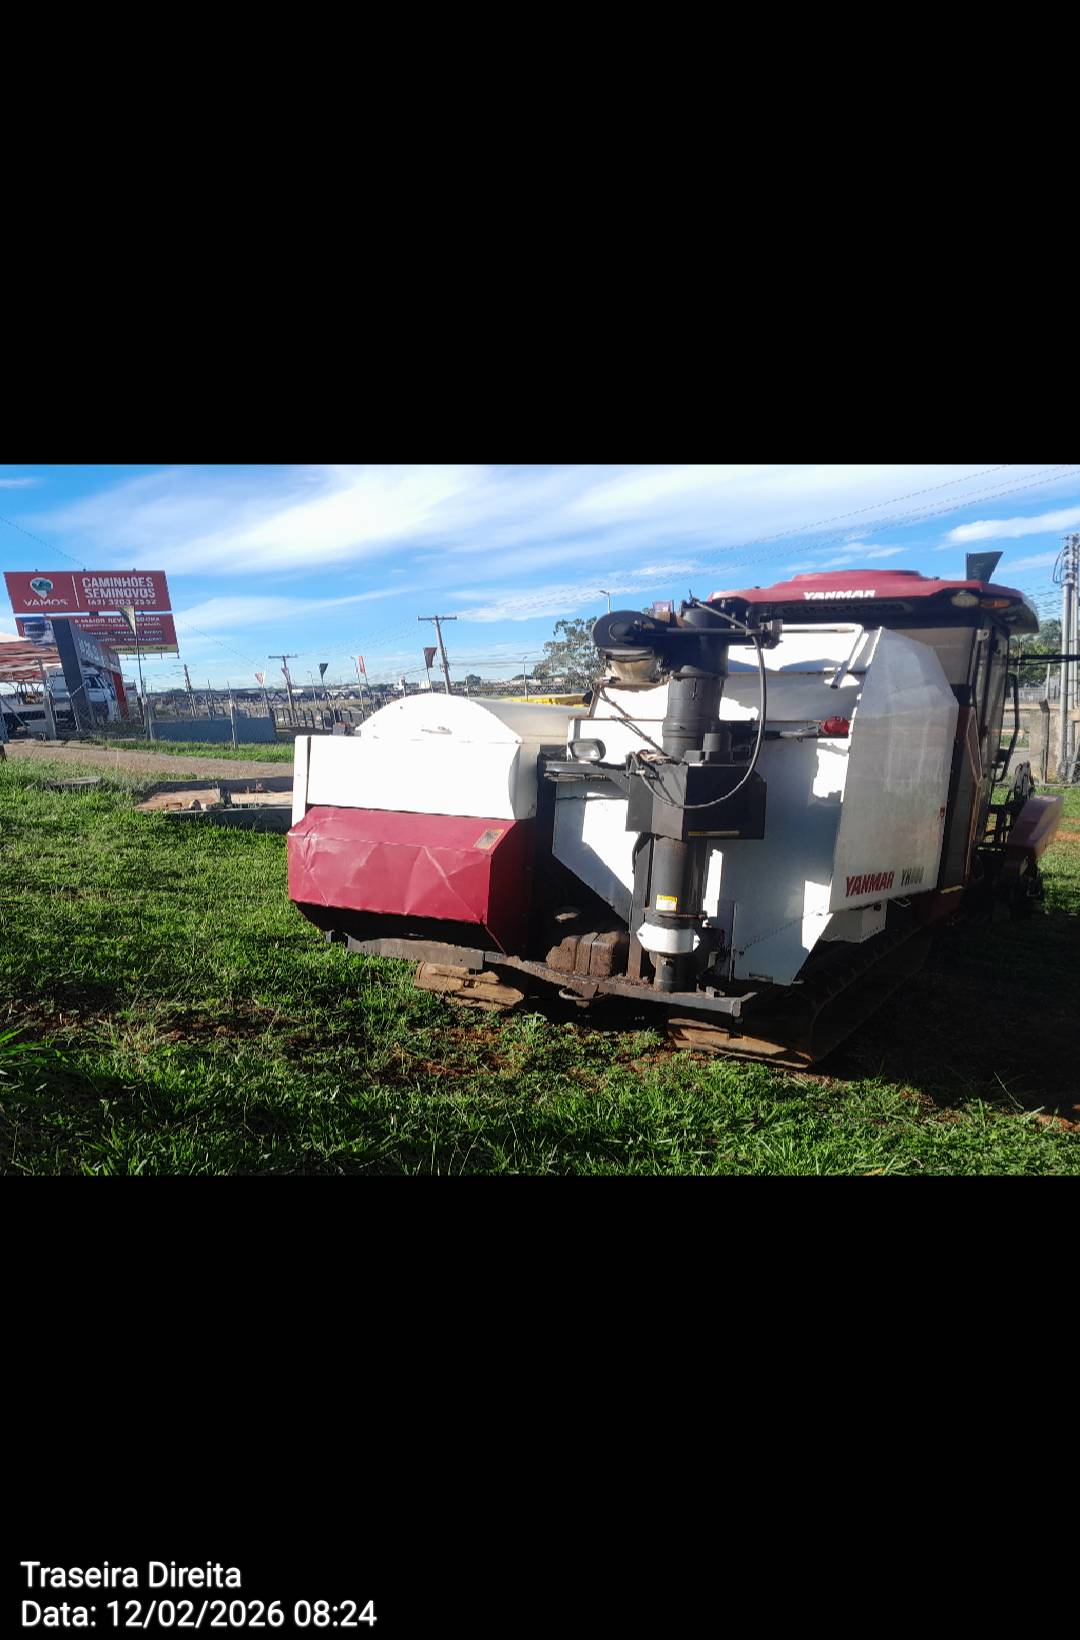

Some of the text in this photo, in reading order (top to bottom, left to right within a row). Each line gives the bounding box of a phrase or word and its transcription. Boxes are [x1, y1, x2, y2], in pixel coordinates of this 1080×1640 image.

[85, 588, 156, 599] SEMINOVOS
[803, 589, 876, 600] YANMAR
[24, 599, 68, 607] VAMOS
[846, 871, 895, 897] YANMAR
